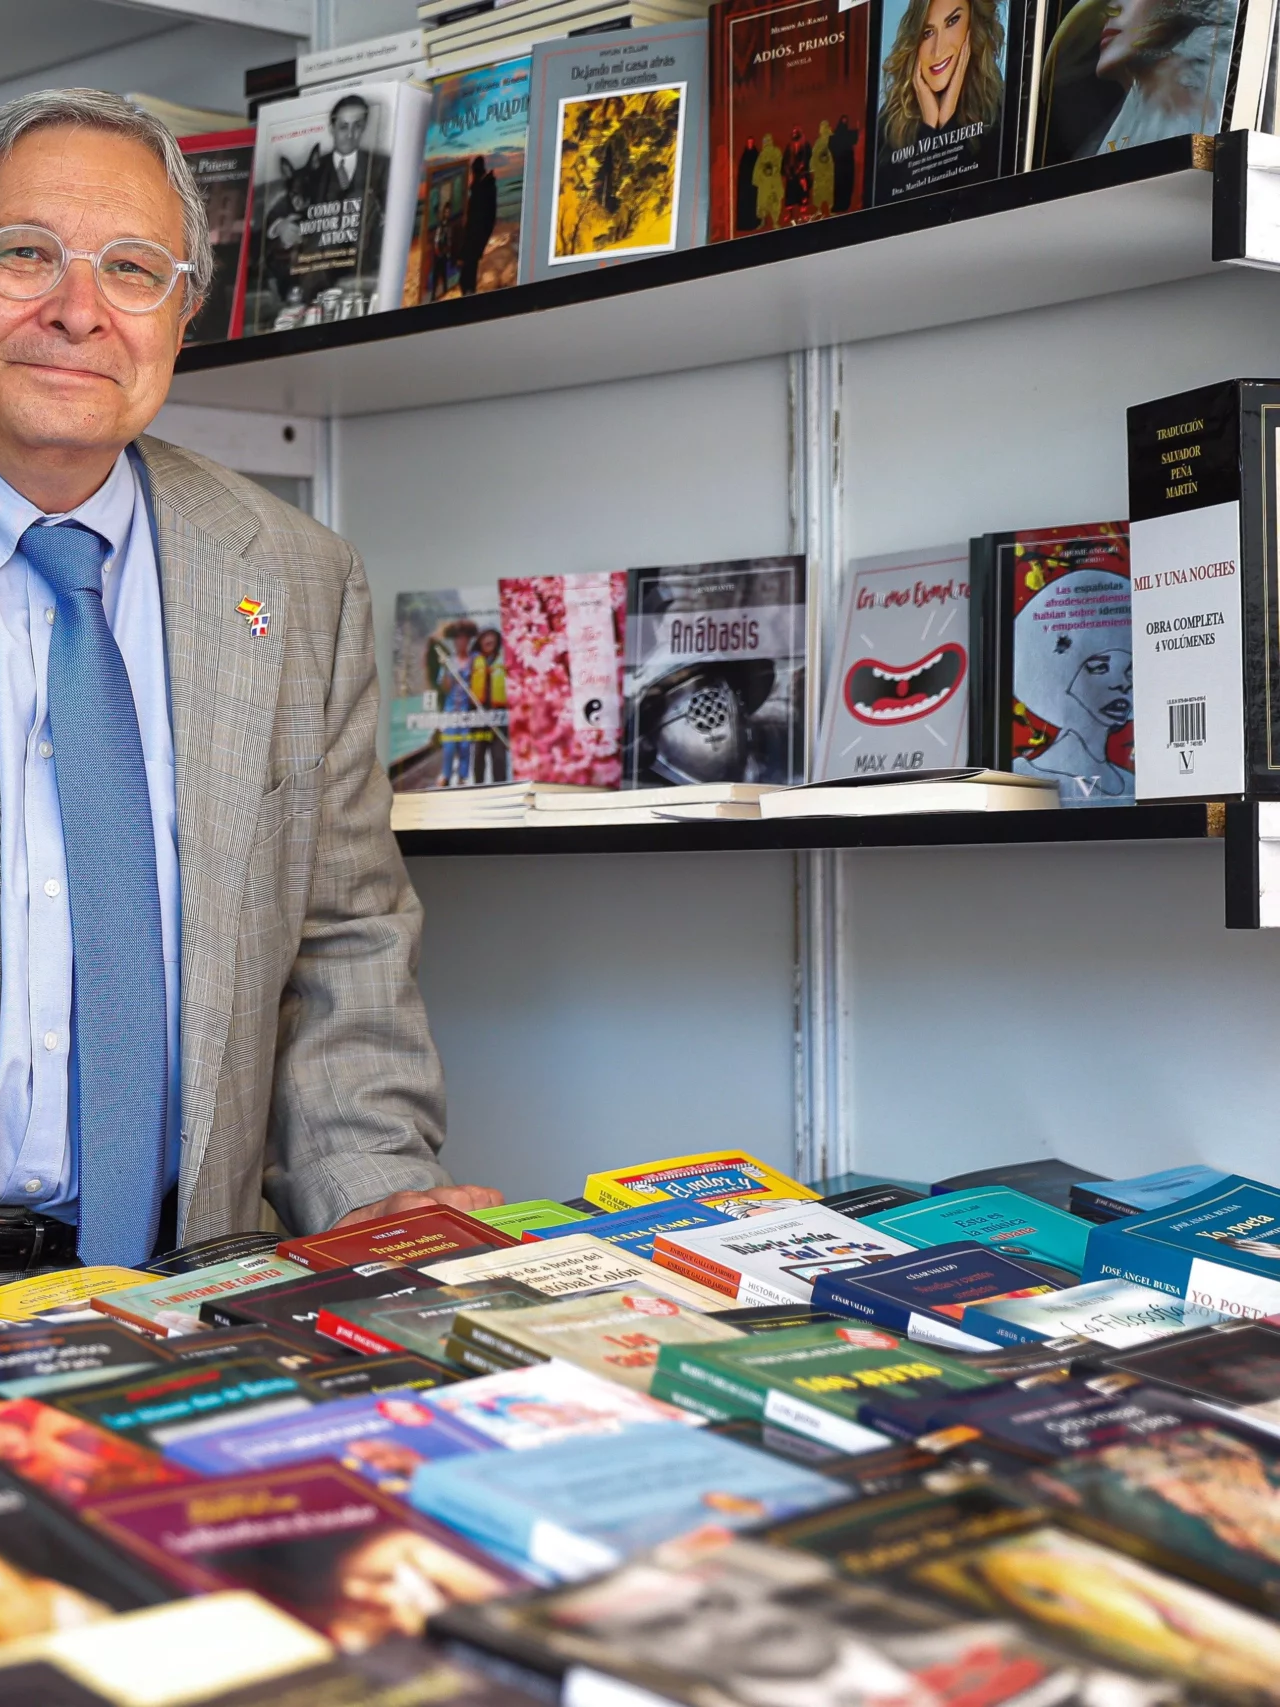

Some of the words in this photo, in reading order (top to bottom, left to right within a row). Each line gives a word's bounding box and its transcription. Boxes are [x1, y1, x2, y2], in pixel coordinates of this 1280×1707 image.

[798, 31, 845, 53] PRIMOS
[571, 62, 610, 80] Dejando
[611, 60, 624, 73] mi
[625, 60, 648, 72] casa
[649, 55, 675, 68] atrás
[594, 78, 619, 90] otros
[621, 72, 657, 86] cuentos
[891, 144, 915, 164] COMO
[916, 136, 931, 155] NO
[932, 121, 983, 150] ENVEJECER
[307, 200, 341, 219] COMO
[342, 197, 362, 214] UN
[299, 216, 339, 235] MOTOR
[341, 213, 361, 230] DE
[1156, 418, 1205, 440] TRADUCCIÓN
[1161, 445, 1201, 464] SALVADOR
[1171, 463, 1193, 480] PEÑA
[1165, 479, 1198, 499] MARTÍN
[1133, 575, 1153, 591] MIL
[1155, 573, 1162, 587] Y
[1164, 569, 1188, 586] UNA
[1189, 560, 1235, 582] NOCHES
[1056, 587, 1072, 596] Las
[1074, 582, 1124, 594] españolas
[1044, 594, 1131, 608] afrodescendiente
[1033, 610, 1067, 621] hablan
[1069, 608, 1097, 618] sobre
[1146, 620, 1172, 635] OBRA
[1173, 611, 1225, 631] COMPLETA
[671, 614, 759, 654] Anábasis
[1155, 640, 1160, 652] 4
[1162, 632, 1216, 651] VOLÚMENES
[854, 753, 888, 773] MAX
[891, 750, 925, 770] AUB
[1179, 750, 1193, 770] V
[1074, 776, 1101, 797] V
[600, 1190, 612, 1200] LUIS
[665, 1181, 689, 1199] El
[688, 1175, 736, 1191] valor
[738, 1177, 751, 1190] y
[598, 1196, 605, 1204] DE
[649, 1216, 708, 1234] CÓMICA
[953, 1215, 987, 1229] Esta
[988, 1212, 1004, 1222] es
[962, 1228, 976, 1238] la
[977, 1217, 1028, 1234] música
[1170, 1220, 1189, 1232] JOSÉ
[1189, 1212, 1214, 1225] ÁNGEL
[1214, 1204, 1242, 1216] BUESA
[1195, 1229, 1234, 1241] Yo,
[1229, 1214, 1275, 1236] poeta
[372, 1228, 408, 1240] VOLTAIRE
[720, 1231, 749, 1243] ENRIQUE
[749, 1225, 775, 1237] GALLUD
[775, 1220, 804, 1232] JARDIEL
[989, 1226, 1037, 1242] cubana
[369, 1238, 416, 1255] Tratado
[415, 1232, 447, 1245] sobre
[388, 1253, 403, 1262] la
[403, 1239, 460, 1260] tolerancia
[721, 1239, 788, 1255] Historia
[788, 1231, 842, 1246] cómica
[780, 1245, 821, 1260] del
[825, 1241, 885, 1256] arte
[243, 1258, 270, 1269] novela
[288, 1252, 310, 1266] VOLTAIRE
[359, 1263, 388, 1275] relatos
[485, 1268, 523, 1281] Diario
[524, 1266, 537, 1276] de
[551, 1256, 583, 1270] bordo
[583, 1252, 603, 1261] del
[670, 1246, 694, 1262] ENRIQUE
[693, 1257, 716, 1272] GALLUD
[714, 1268, 736, 1282] JARDIEL
[539, 1274, 592, 1294] stóbal
[593, 1265, 645, 1285] Colón
[557, 1266, 584, 1279] viaje
[585, 1263, 602, 1272] de
[667, 1260, 690, 1276] ENRIQUE
[690, 1271, 713, 1286] GALLUD
[711, 1281, 733, 1296] JARDIEL
[906, 1271, 927, 1281] CÉSAR
[928, 1264, 958, 1276] VALLEJO
[1100, 1264, 1122, 1277] JOSÉ
[1122, 1271, 1152, 1287] ÁNGEL
[1153, 1281, 1181, 1295] BUESA
[151, 1297, 170, 1307] EL
[166, 1284, 224, 1302] INVIERNO
[220, 1279, 239, 1291] DE
[238, 1268, 284, 1286] GUNTER
[747, 1281, 781, 1302] HISTORIA
[914, 1280, 952, 1295] Novelas
[961, 1271, 996, 1283] cuentos
[831, 1294, 850, 1307] CÉSAR
[850, 1300, 875, 1316] VALLEJO
[1192, 1290, 1215, 1309] YO,
[1220, 1299, 1269, 1320] POETA
[996, 1328, 1019, 1341] JESÚS
[1060, 1321, 1099, 1336] La
